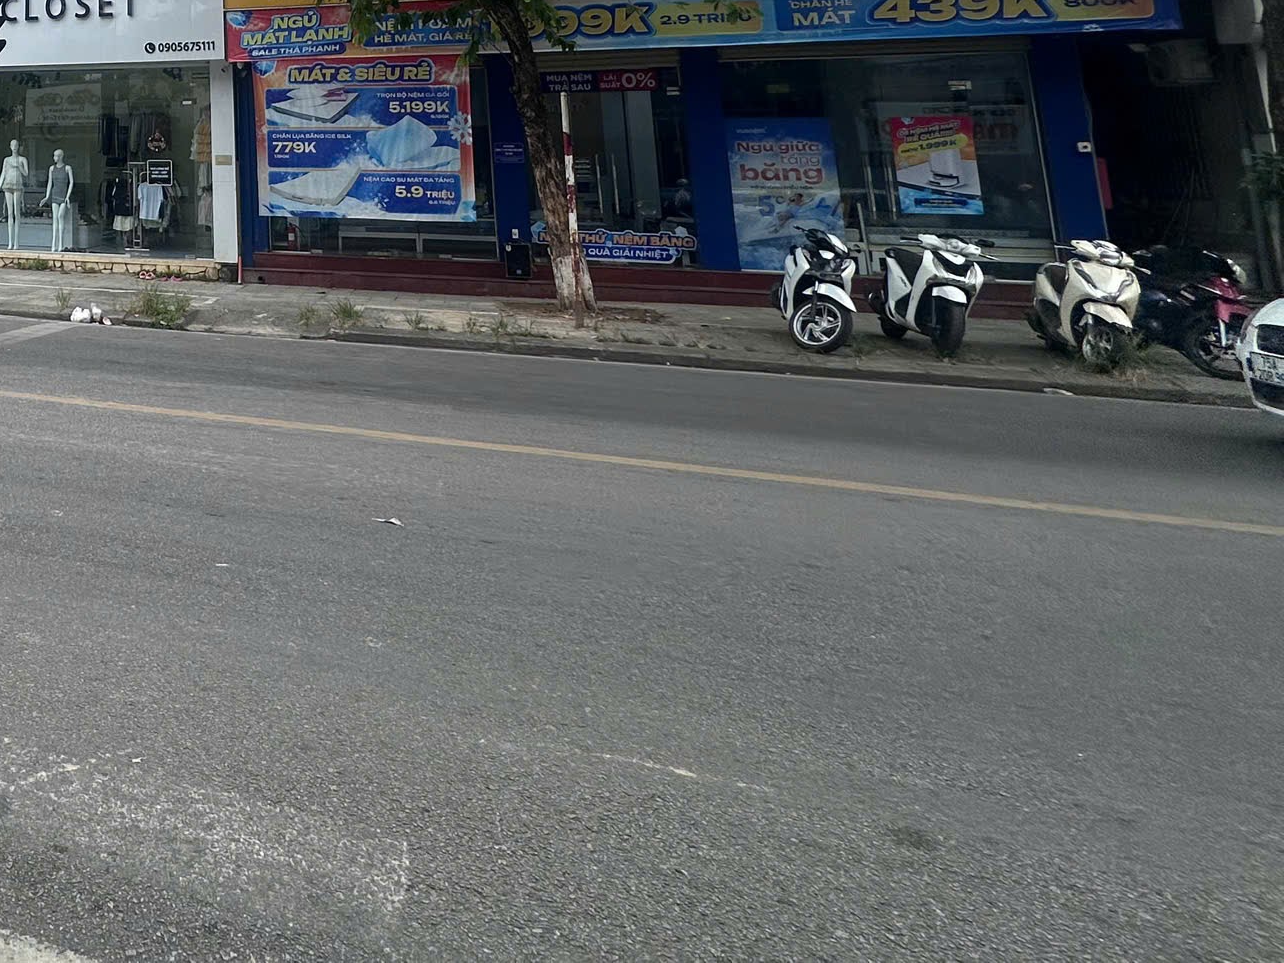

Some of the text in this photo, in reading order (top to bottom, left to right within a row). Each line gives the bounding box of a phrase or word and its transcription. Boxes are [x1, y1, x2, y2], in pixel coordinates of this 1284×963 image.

[272, 11, 318, 30] NGỦ
[792, 8, 857, 28] MÁT
[242, 25, 349, 47] MÁT LẠNH
[429, 29, 452, 42] GIÁ
[157, 40, 216, 53] 0905675111
[251, 47, 278, 58] SALE
[302, 43, 340, 55] PHANH
[290, 60, 433, 83] MÁT & SIÊU RẺ
[571, 83, 592, 91] SAU
[621, 71, 656, 88] 0%
[388, 100, 450, 114] 5.199K
[272, 141, 317, 154] 779K
[739, 162, 823, 185] băng
[394, 185, 455, 200] 5.9 TRIỆU
[650, 232, 694, 248] BĂNG
